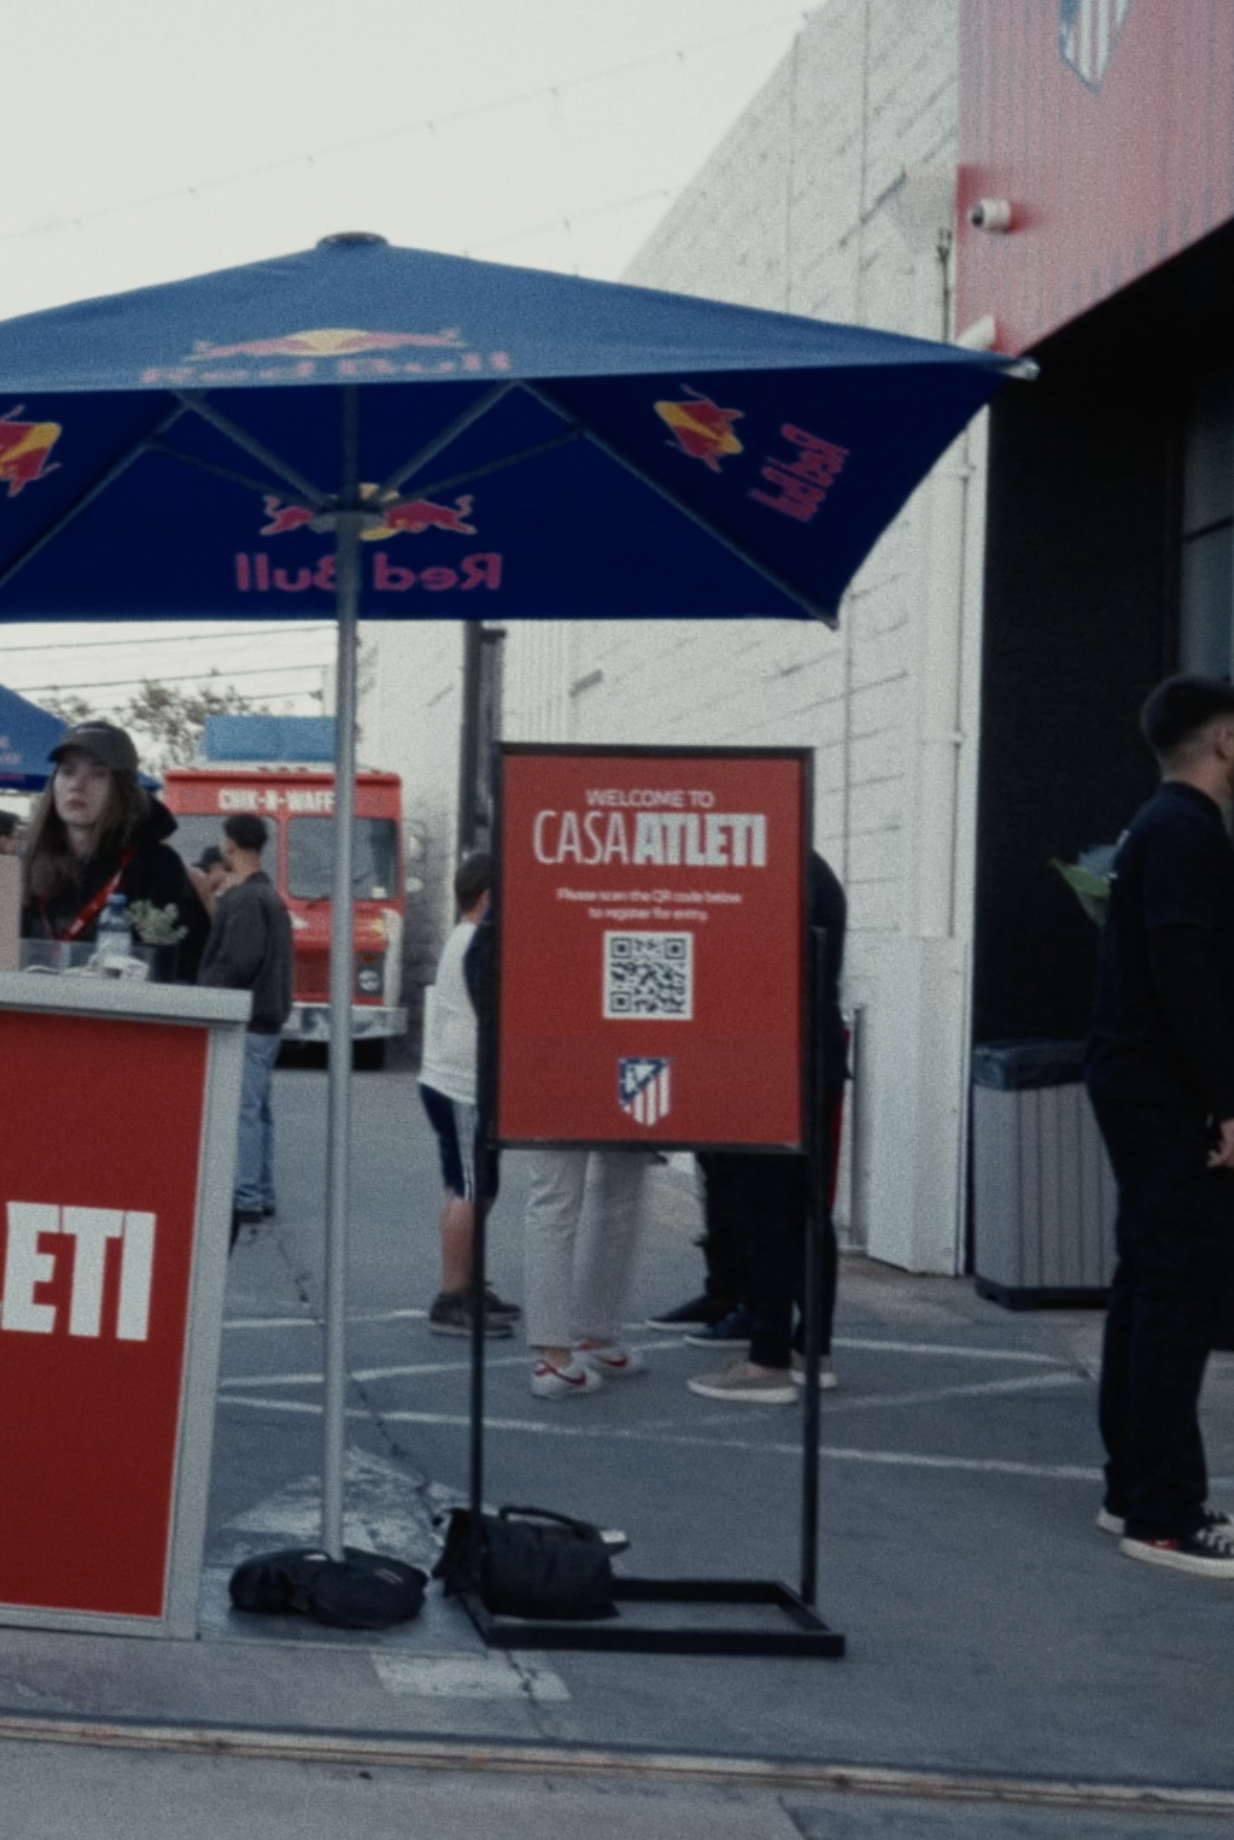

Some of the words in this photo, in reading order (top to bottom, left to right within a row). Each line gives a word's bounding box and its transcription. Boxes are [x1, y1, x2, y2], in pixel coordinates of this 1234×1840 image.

[586, 788, 684, 808] WELCOME
[687, 790, 715, 808] TO
[653, 890, 671, 904] QR
